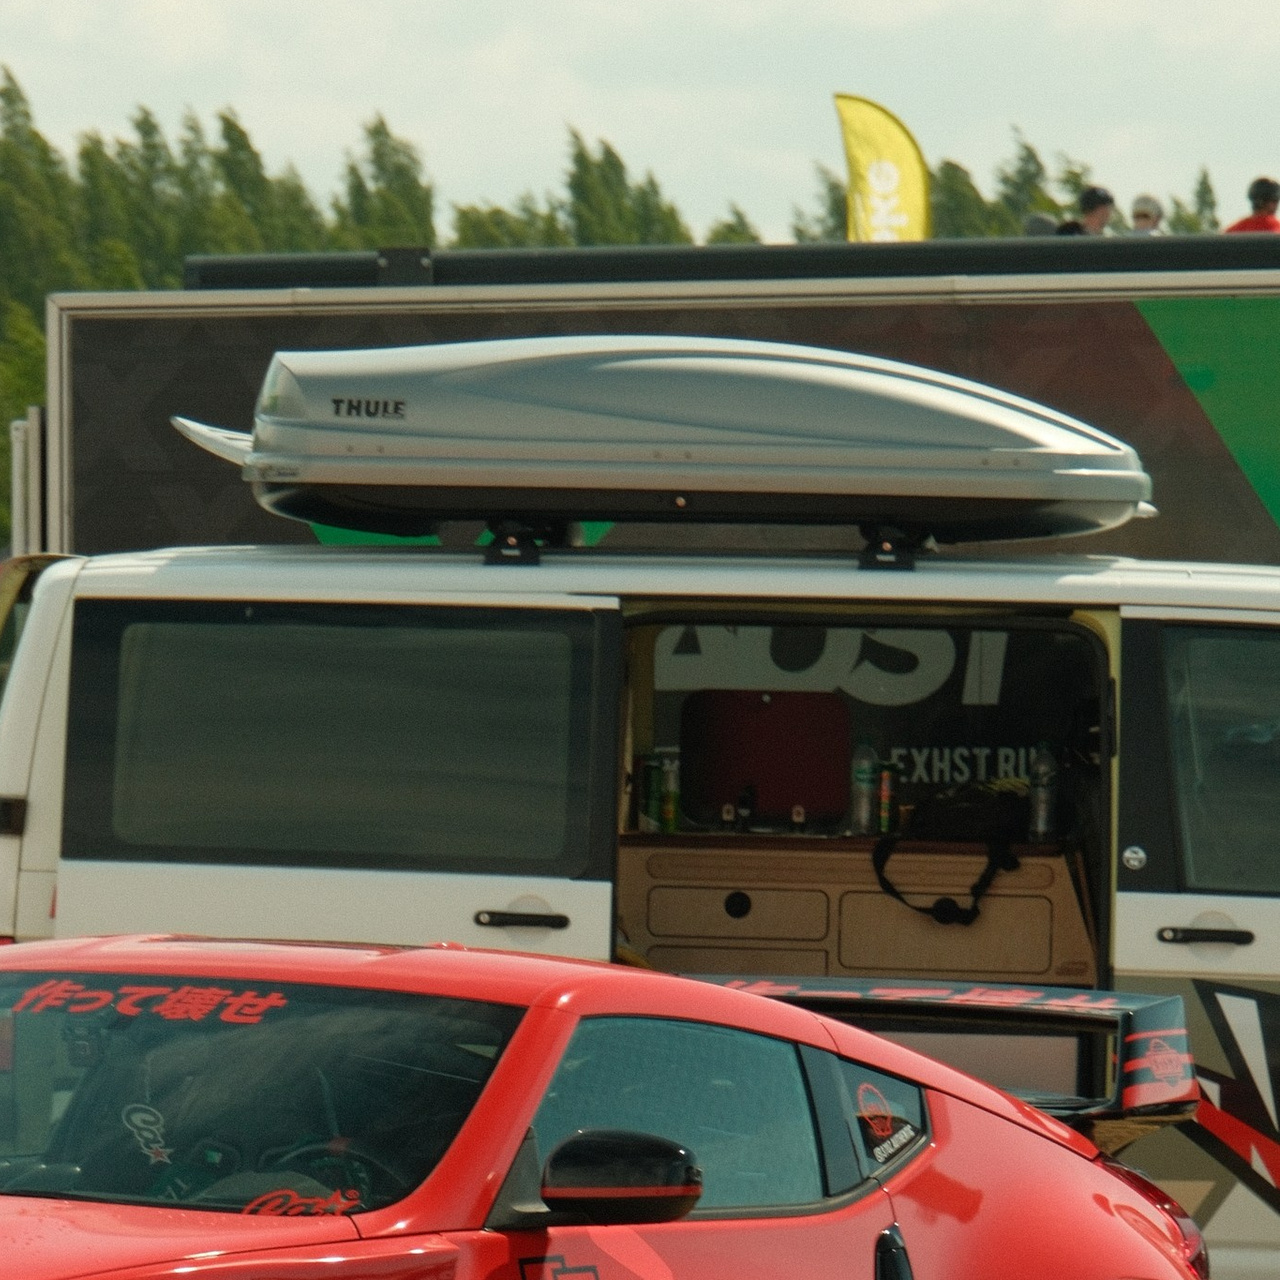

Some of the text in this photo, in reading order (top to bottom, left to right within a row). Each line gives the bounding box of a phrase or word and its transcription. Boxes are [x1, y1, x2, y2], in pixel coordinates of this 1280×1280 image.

[331, 398, 406, 420] THULE
[13, 979, 289, 1024] 作って壊せ
